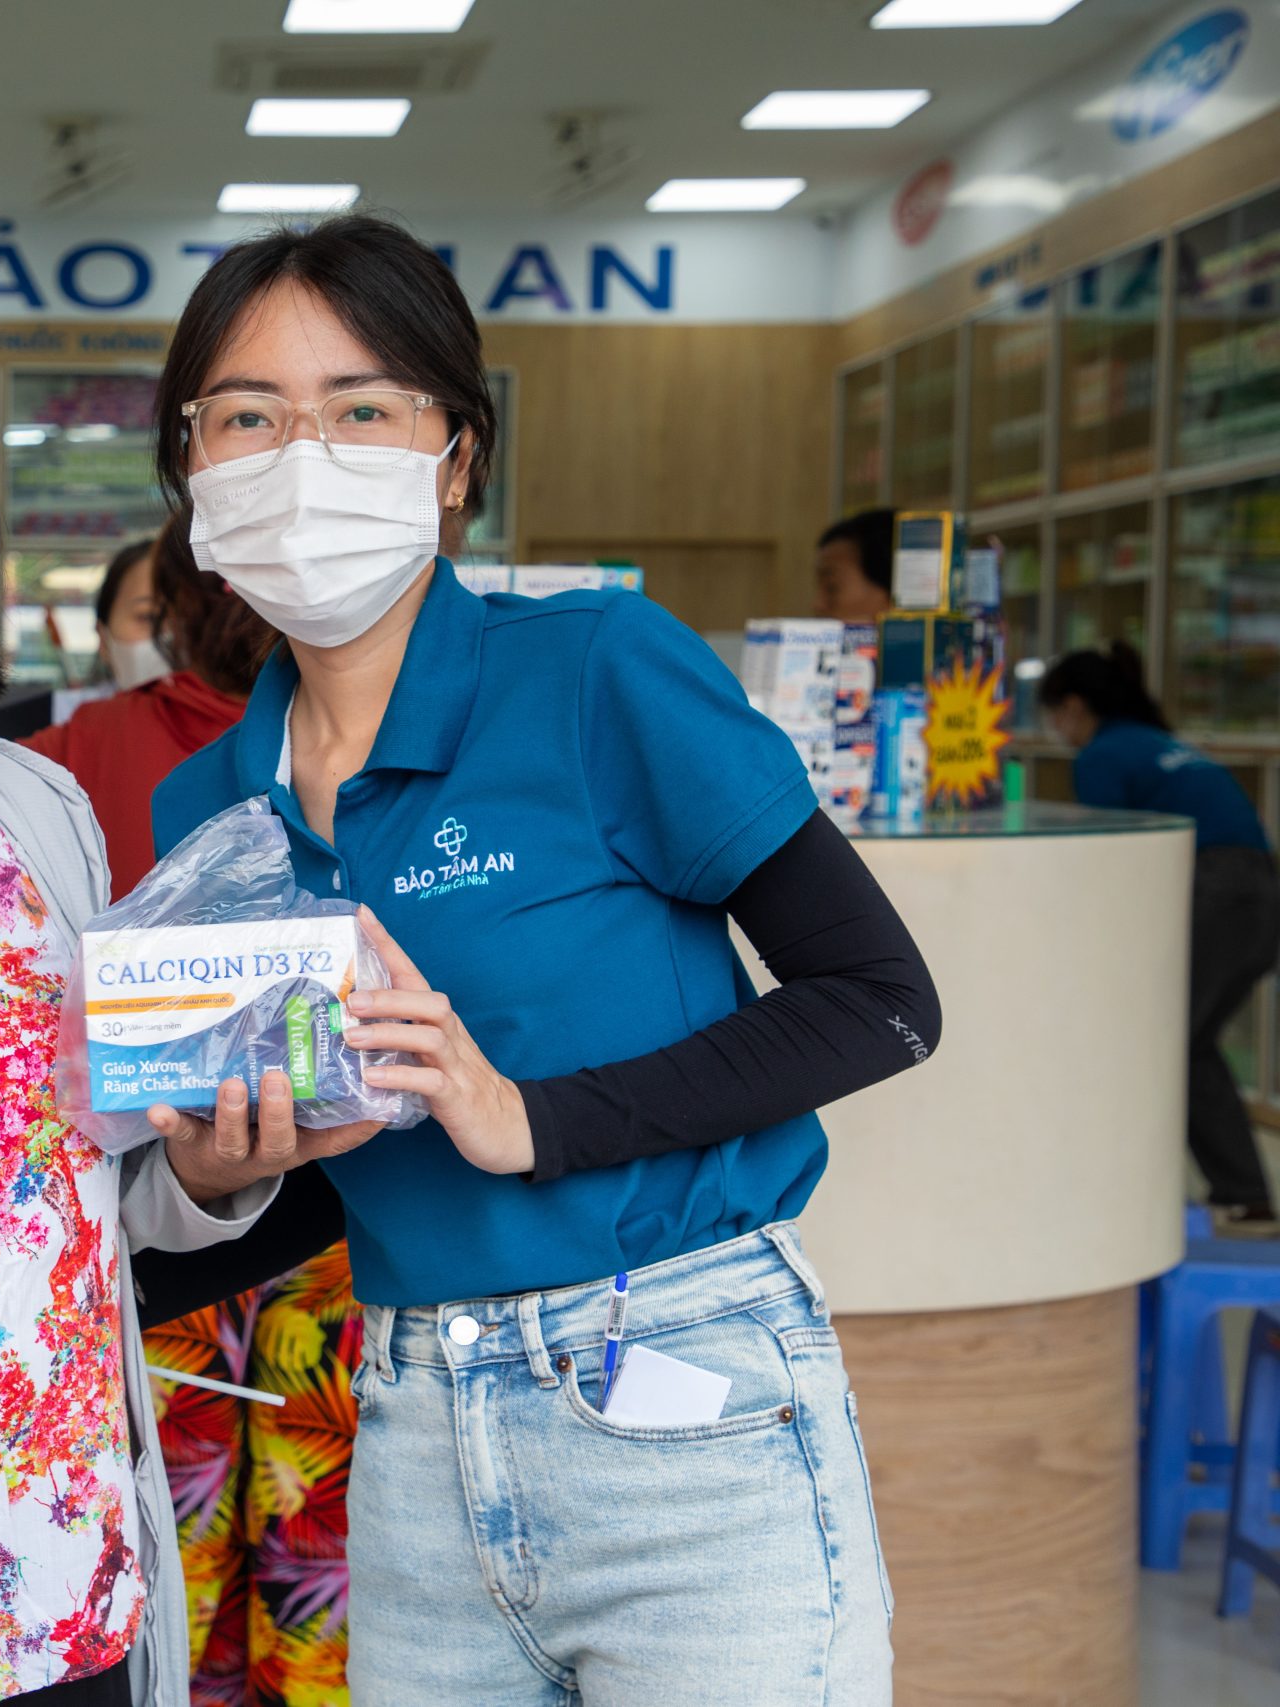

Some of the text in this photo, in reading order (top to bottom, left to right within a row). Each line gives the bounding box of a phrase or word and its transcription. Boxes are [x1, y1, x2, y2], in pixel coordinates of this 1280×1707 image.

[487, 244, 674, 310] AN
[393, 852, 515, 894] BẢO TÂM AN
[98, 950, 333, 985] CALCIQIN D3 K2
[102, 1021, 123, 1037] 30
[102, 1061, 136, 1077] Giúp
[103, 1080, 139, 1095] Răng
[142, 1075, 179, 1091] Chắc
